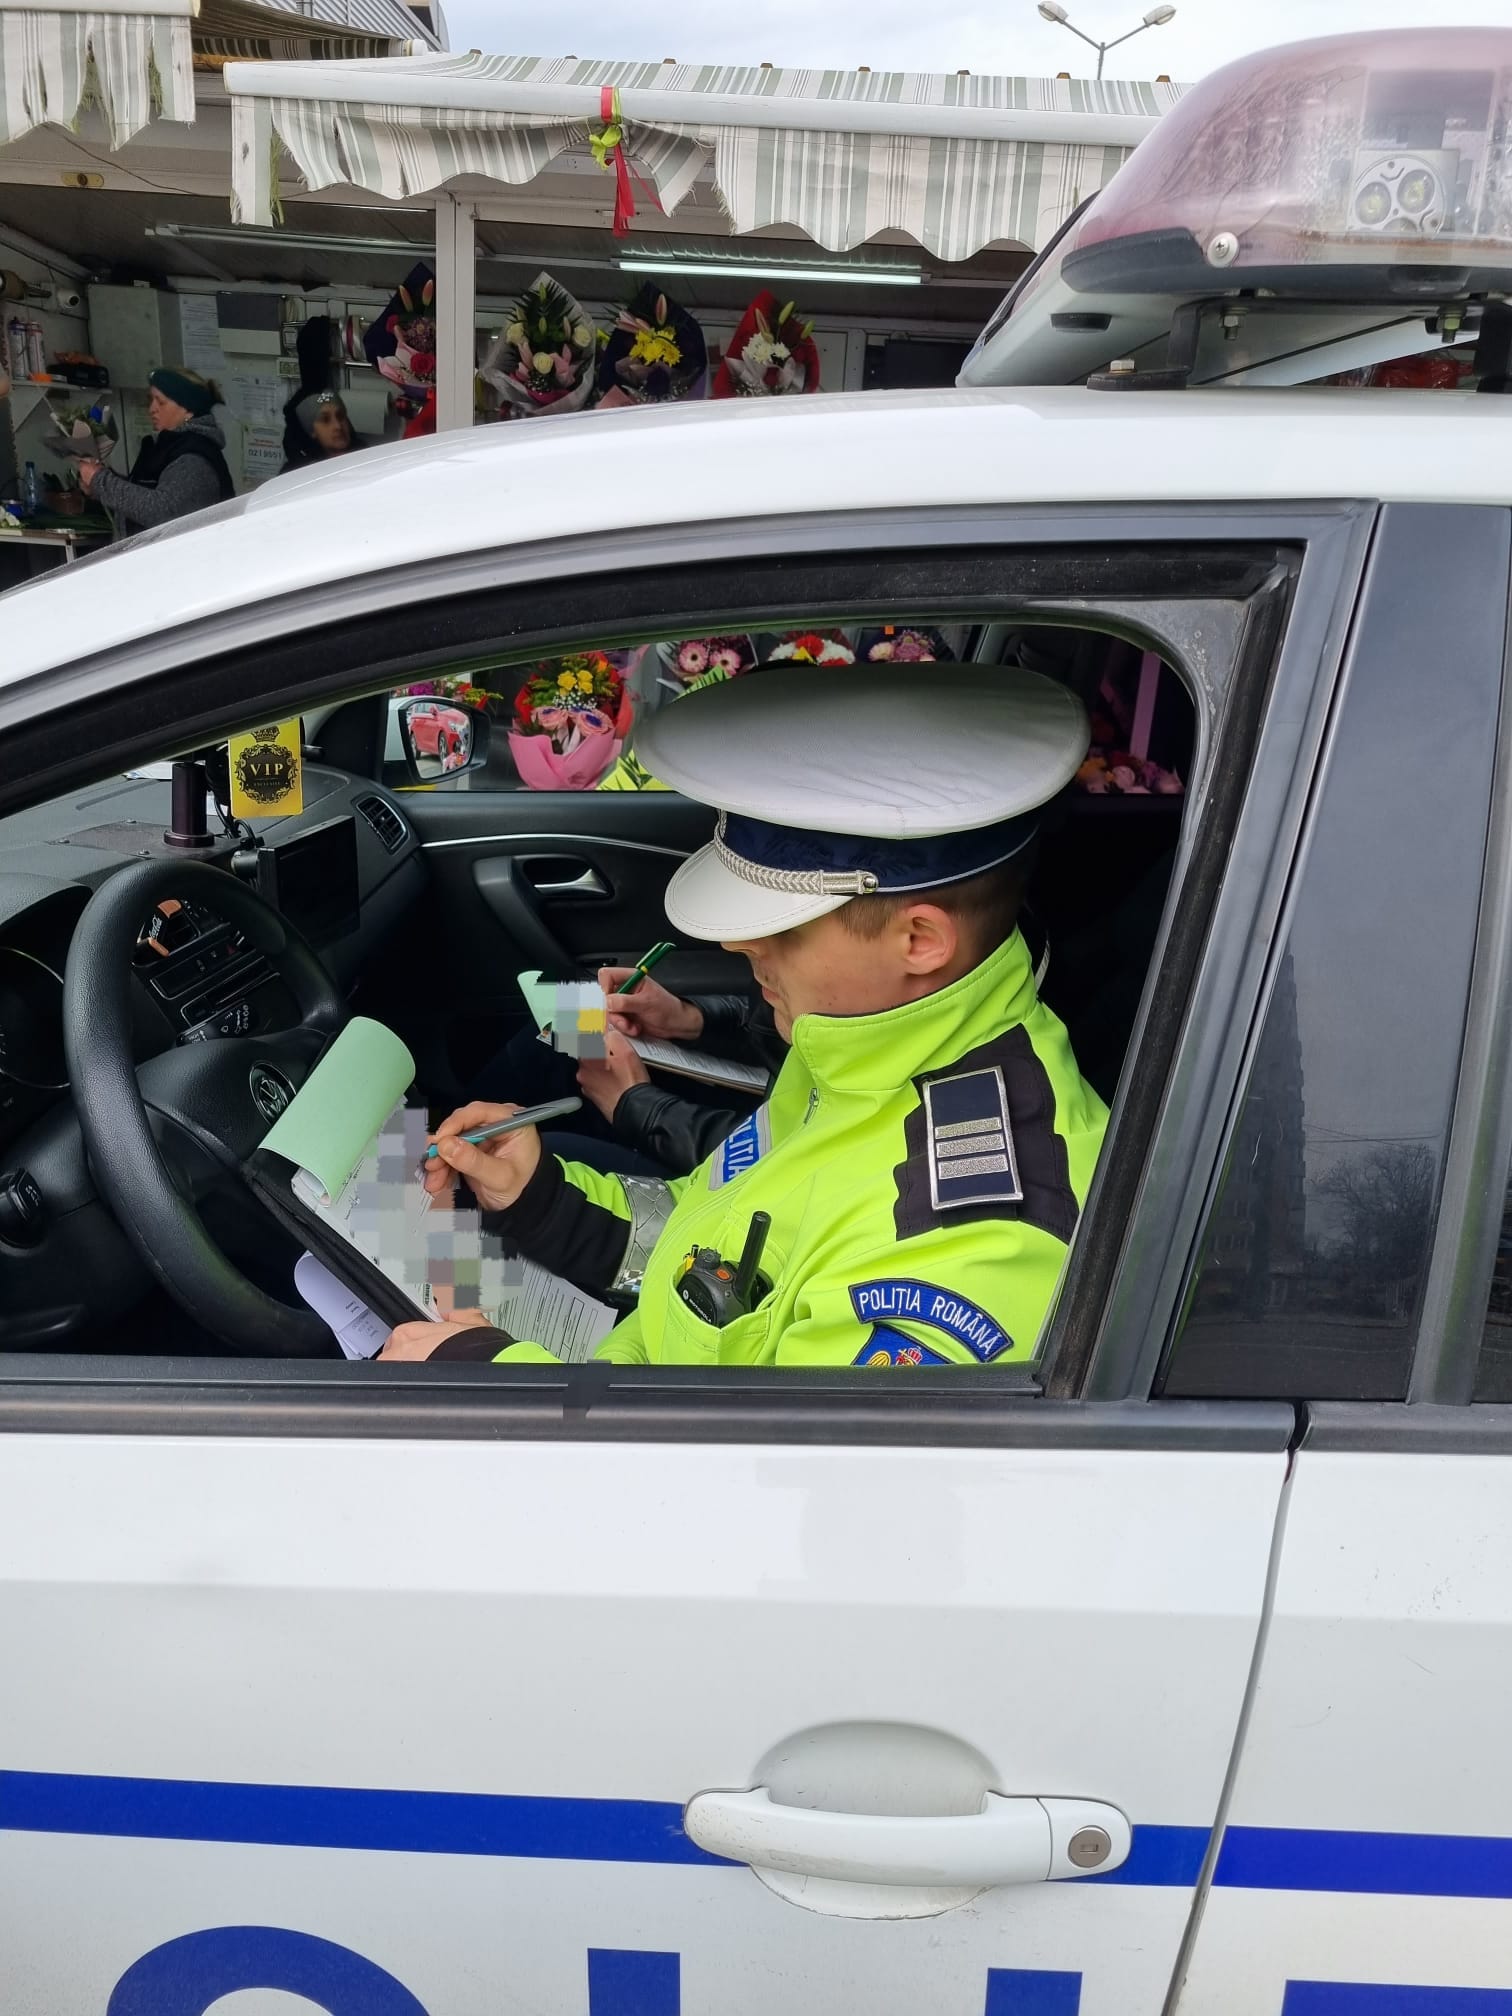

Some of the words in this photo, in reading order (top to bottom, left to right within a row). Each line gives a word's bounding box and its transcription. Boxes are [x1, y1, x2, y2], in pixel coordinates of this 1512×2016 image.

[249, 763, 284, 776] VIP
[859, 1287, 921, 1315] POLIȚIA
[930, 1296, 1002, 1355] ROMÂNĂ
